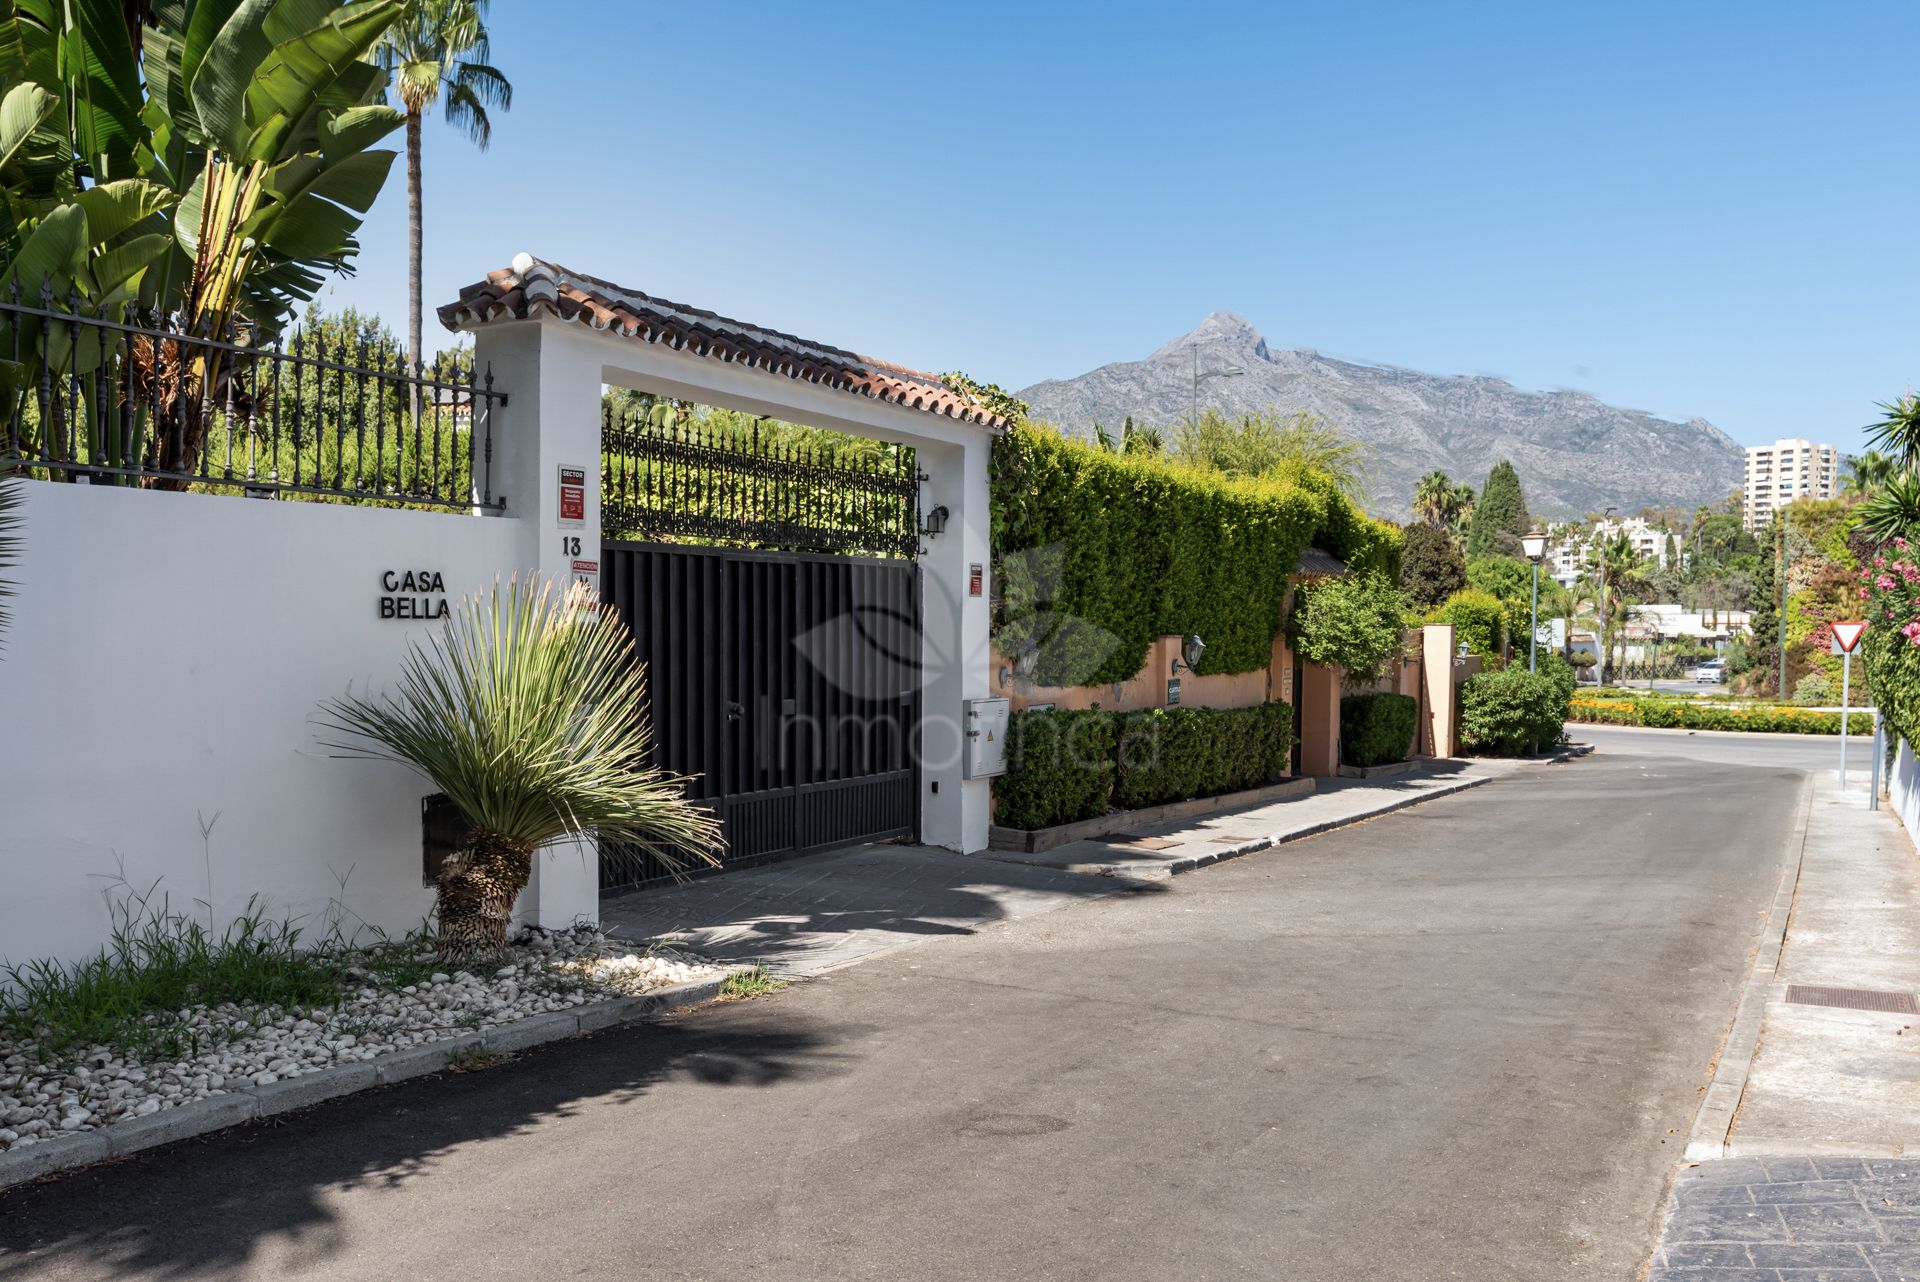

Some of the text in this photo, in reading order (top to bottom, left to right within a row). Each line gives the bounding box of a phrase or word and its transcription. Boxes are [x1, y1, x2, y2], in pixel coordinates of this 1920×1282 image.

[562, 470, 584, 478] SECTOR
[563, 536, 581, 556] 13
[383, 570, 446, 592] CASA
[380, 597, 451, 619] BELLA
